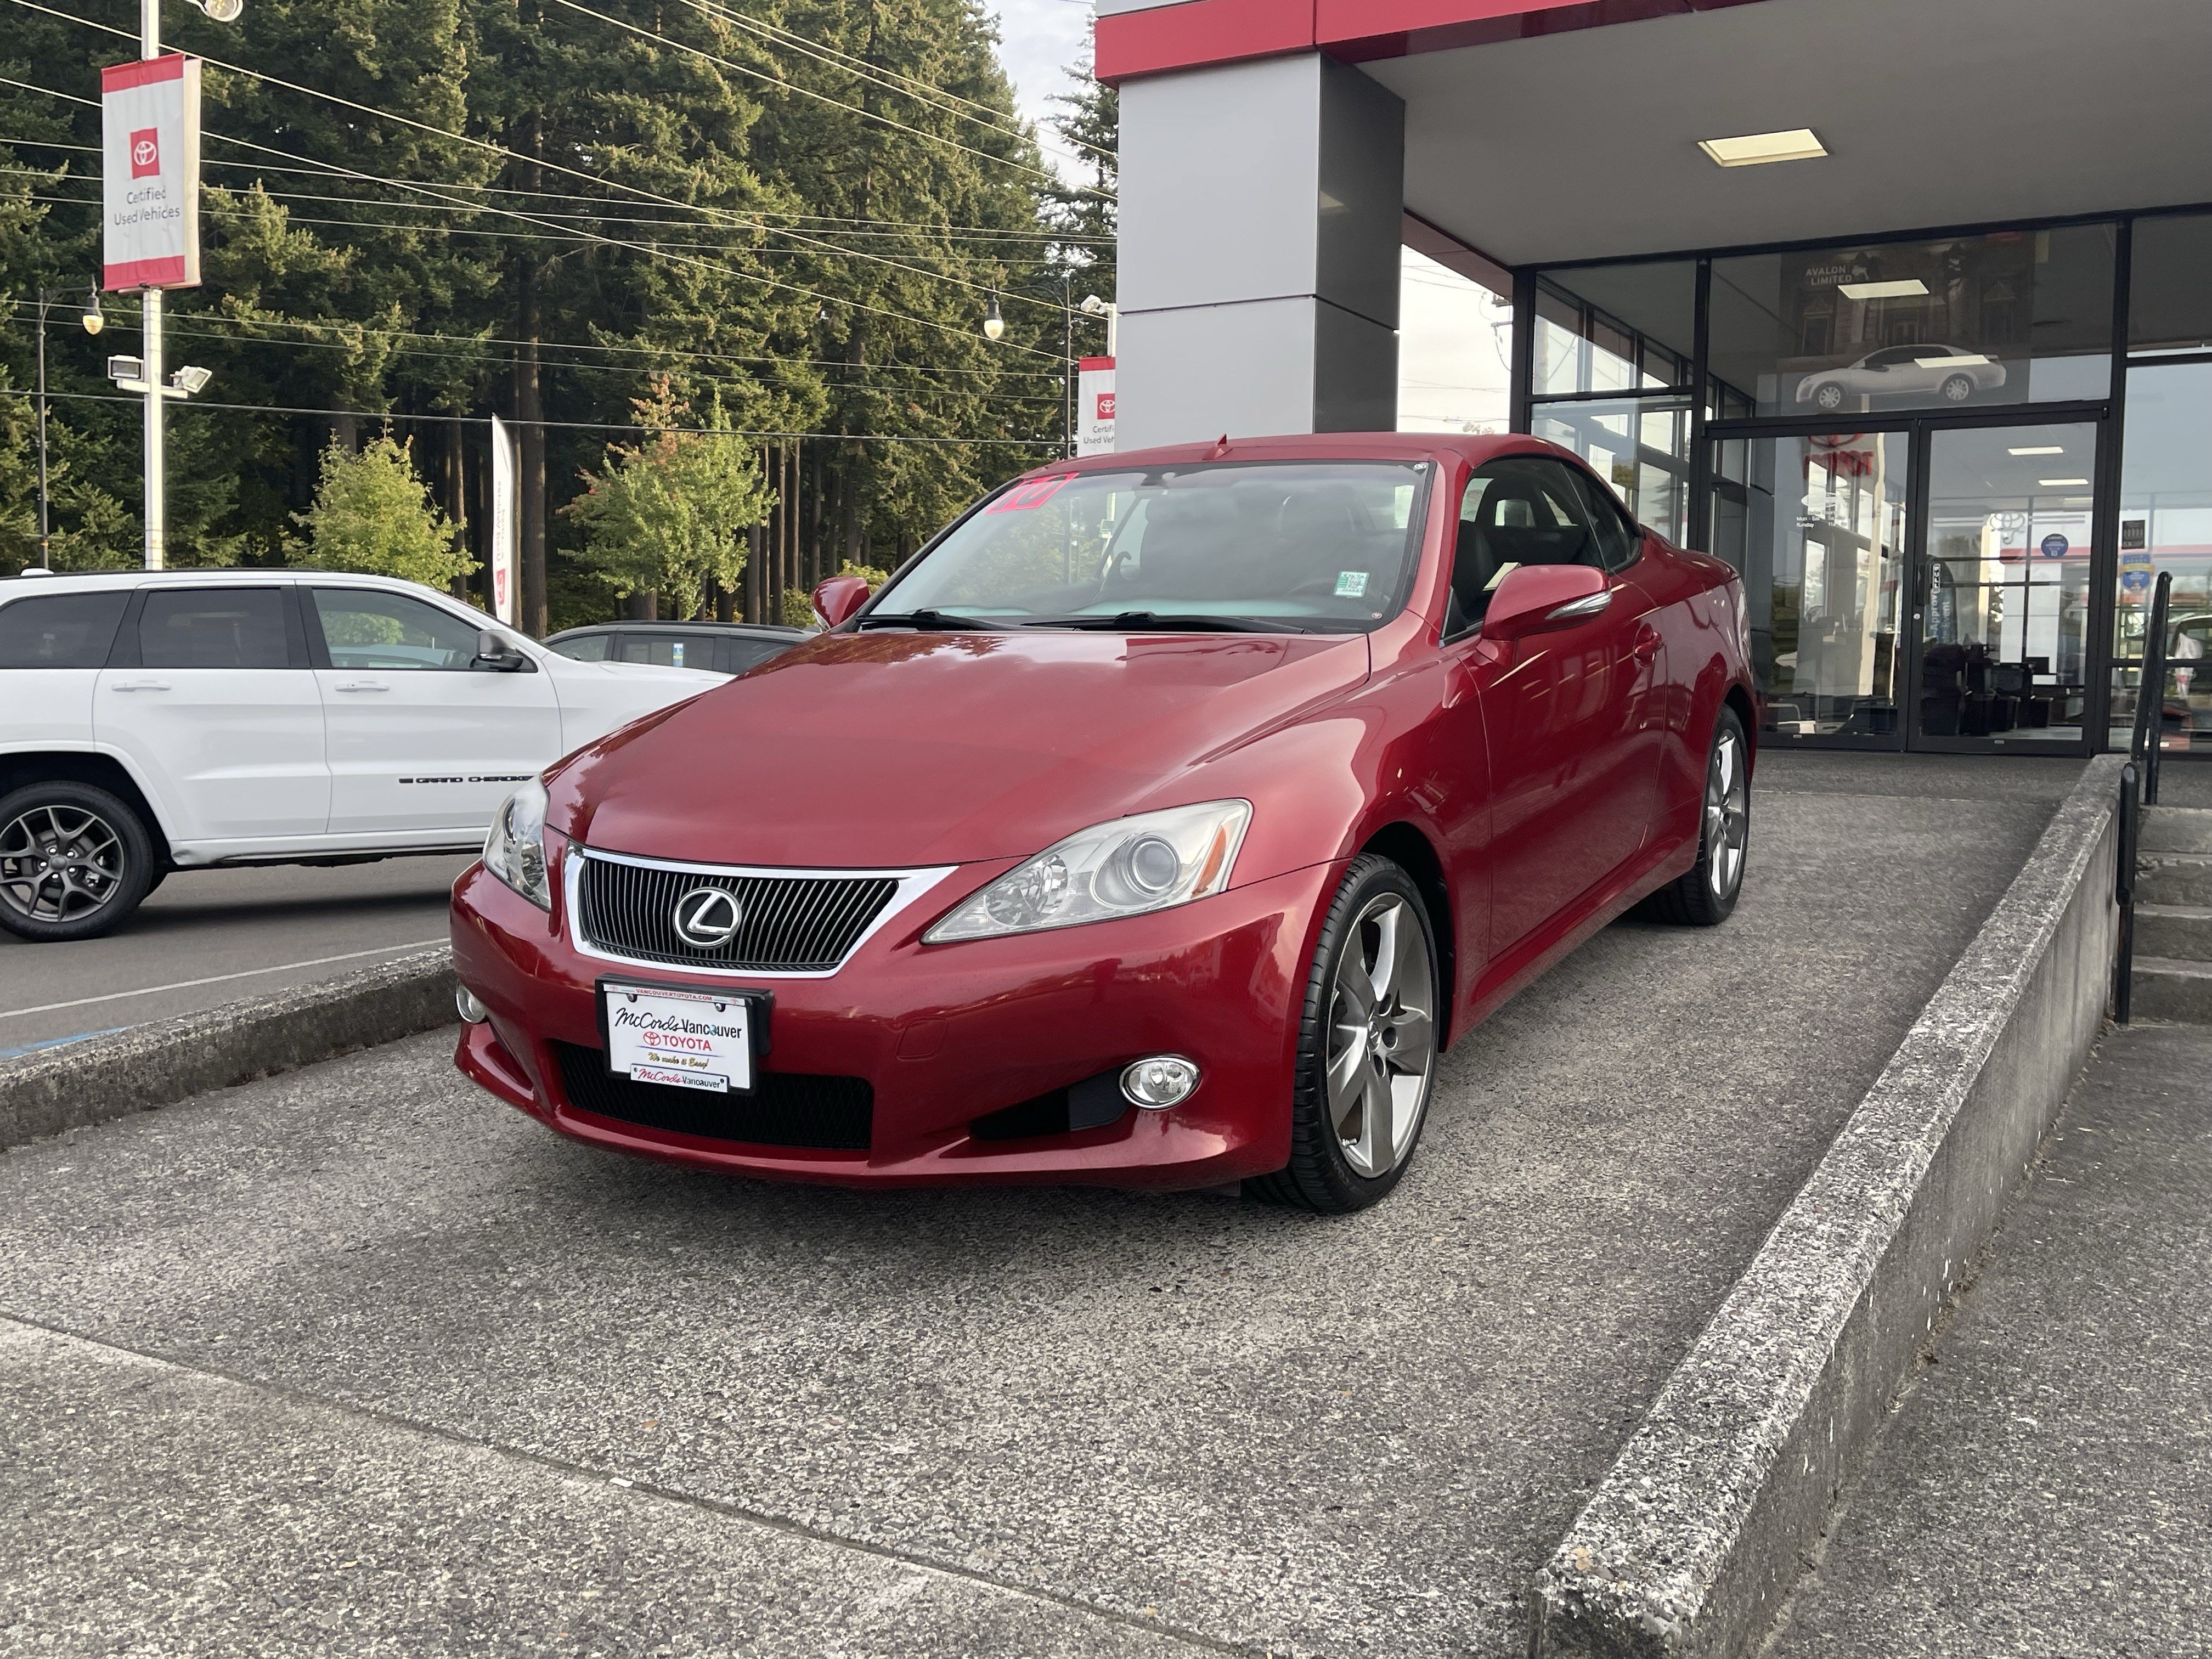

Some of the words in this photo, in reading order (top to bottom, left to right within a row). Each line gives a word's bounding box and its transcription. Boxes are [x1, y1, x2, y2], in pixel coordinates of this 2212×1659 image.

[127, 185, 166, 204] Cetified
[114, 210, 138, 225] Used
[1805, 266, 1846, 276] AVALON
[1811, 275, 1852, 285] LIMITED
[1093, 425, 1115, 433] Certifi
[635, 989, 713, 1001] VANCOUVERTOYOTA.COM
[662, 1035, 712, 1052] TOYOTA
